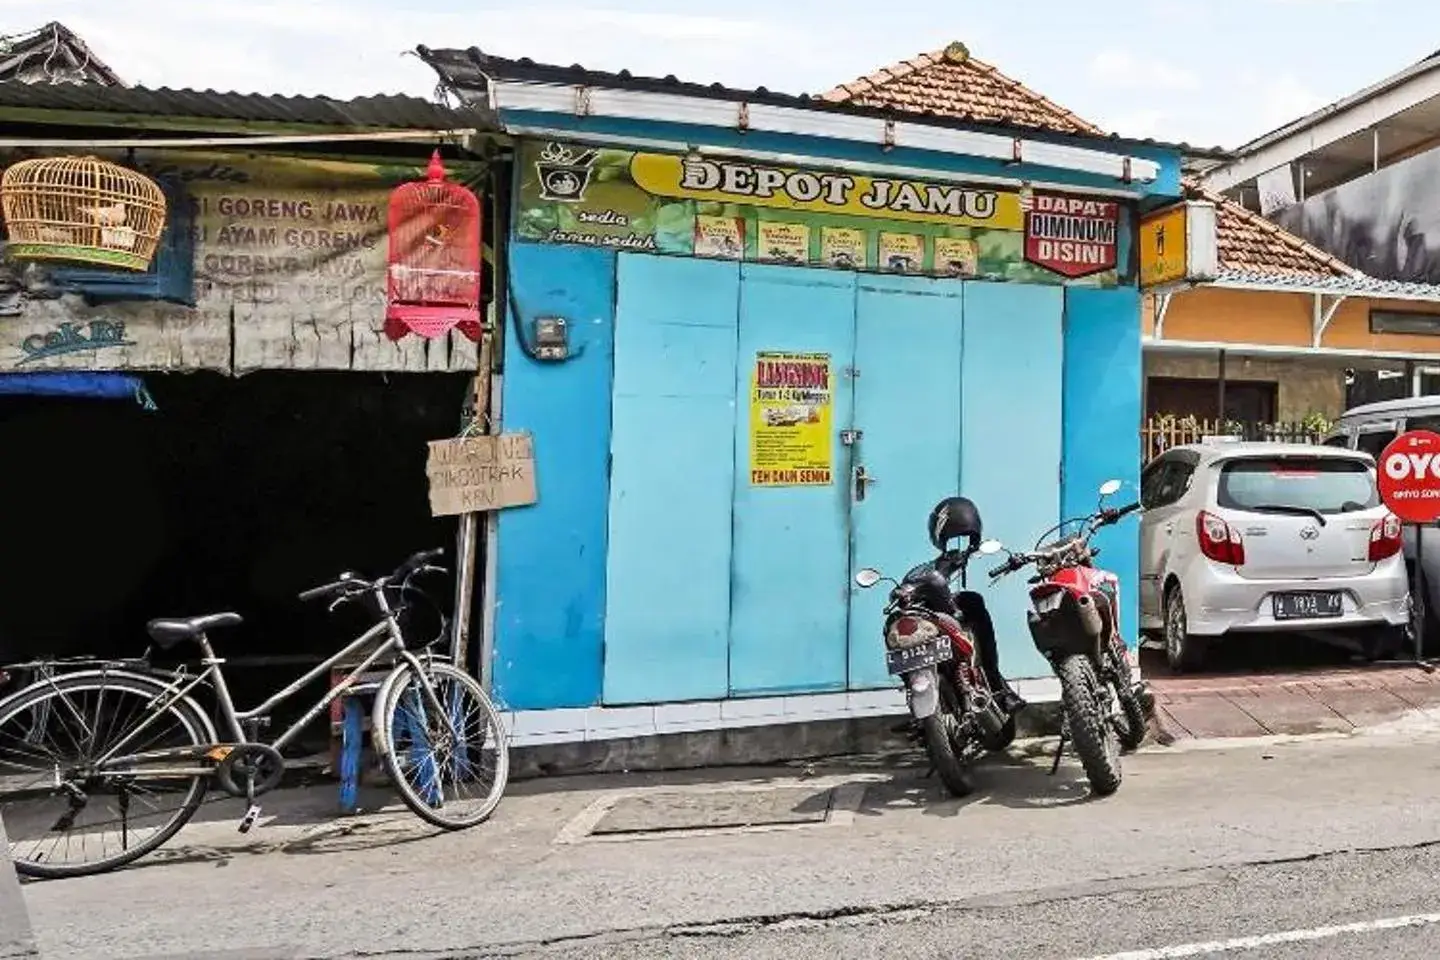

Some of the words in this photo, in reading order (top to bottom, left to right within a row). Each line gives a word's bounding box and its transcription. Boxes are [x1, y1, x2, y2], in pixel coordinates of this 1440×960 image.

[682, 159, 853, 205] DEPOT
[861, 177, 998, 219] JAMU
[218, 197, 312, 221] GORENG
[320, 201, 380, 222] JAWA
[579, 210, 628, 227] sedia
[1037, 196, 1109, 216] DAPAT
[217, 225, 276, 246] AYAM
[283, 228, 376, 251] GORENG
[1032, 214, 1113, 244] DIMINUM
[1038, 241, 1105, 264] DISINI
